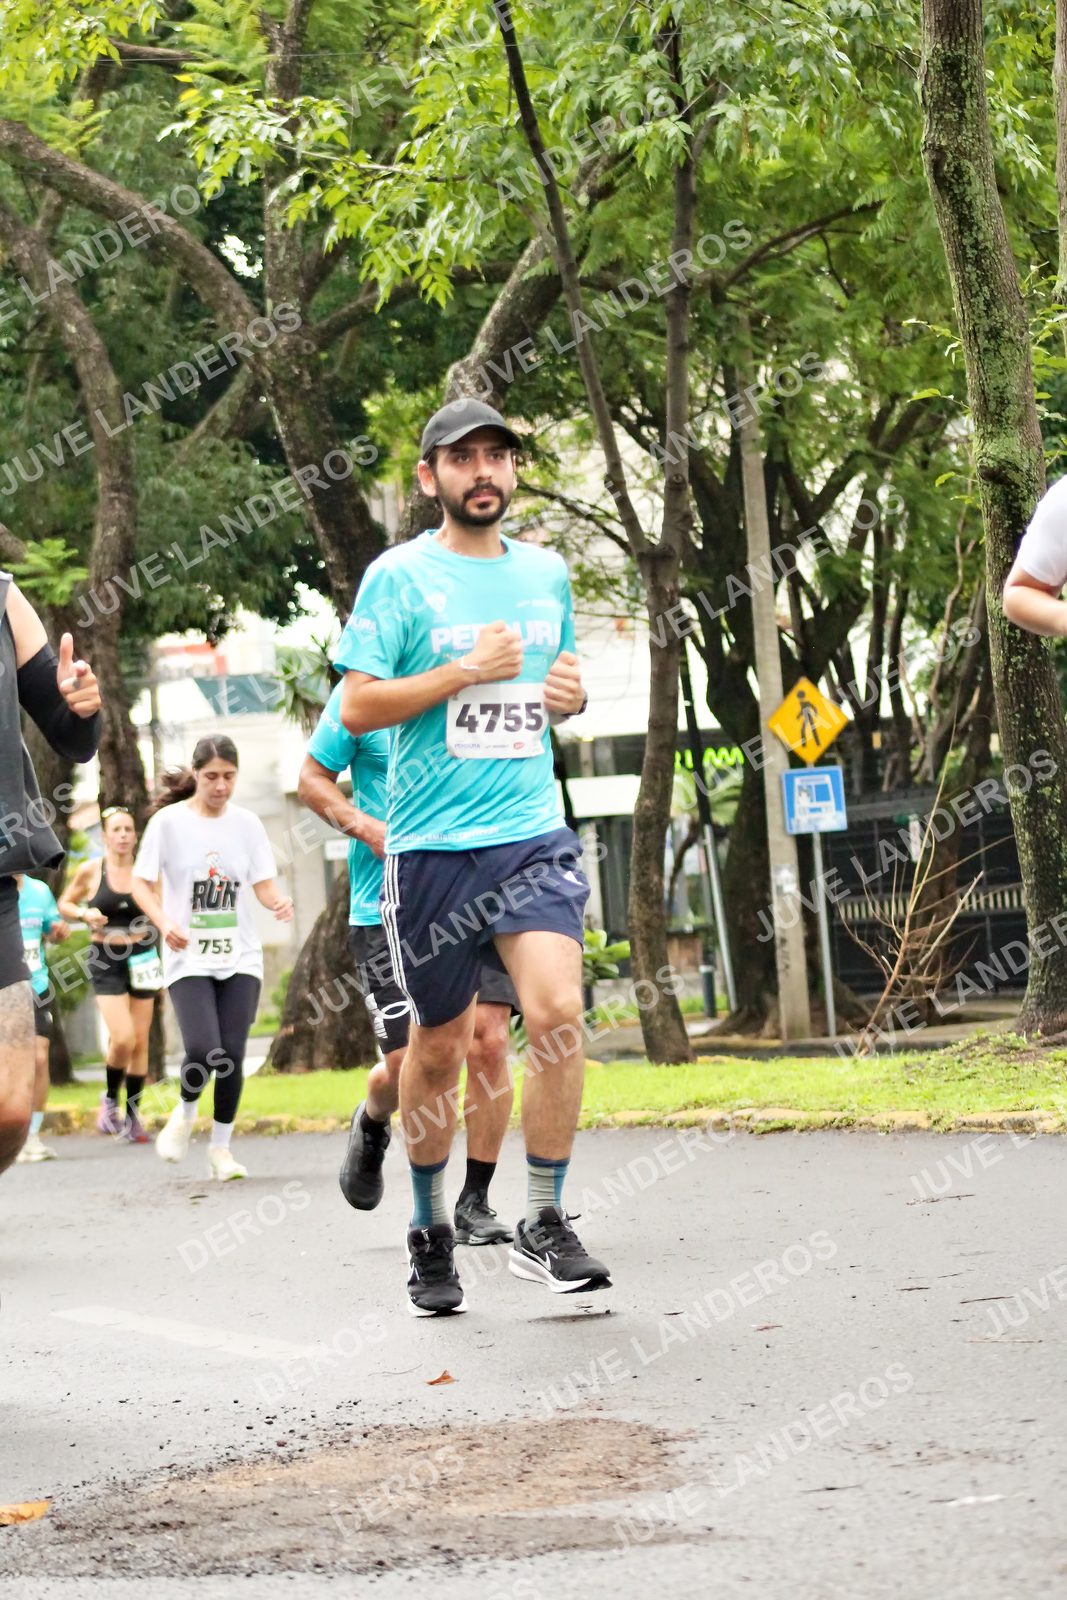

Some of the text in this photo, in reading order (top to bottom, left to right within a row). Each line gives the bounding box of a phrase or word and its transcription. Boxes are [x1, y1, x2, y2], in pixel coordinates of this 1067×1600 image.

[455, 702, 543, 733] 4755
[191, 880, 242, 912] RUN
[198, 938, 233, 955] 753
